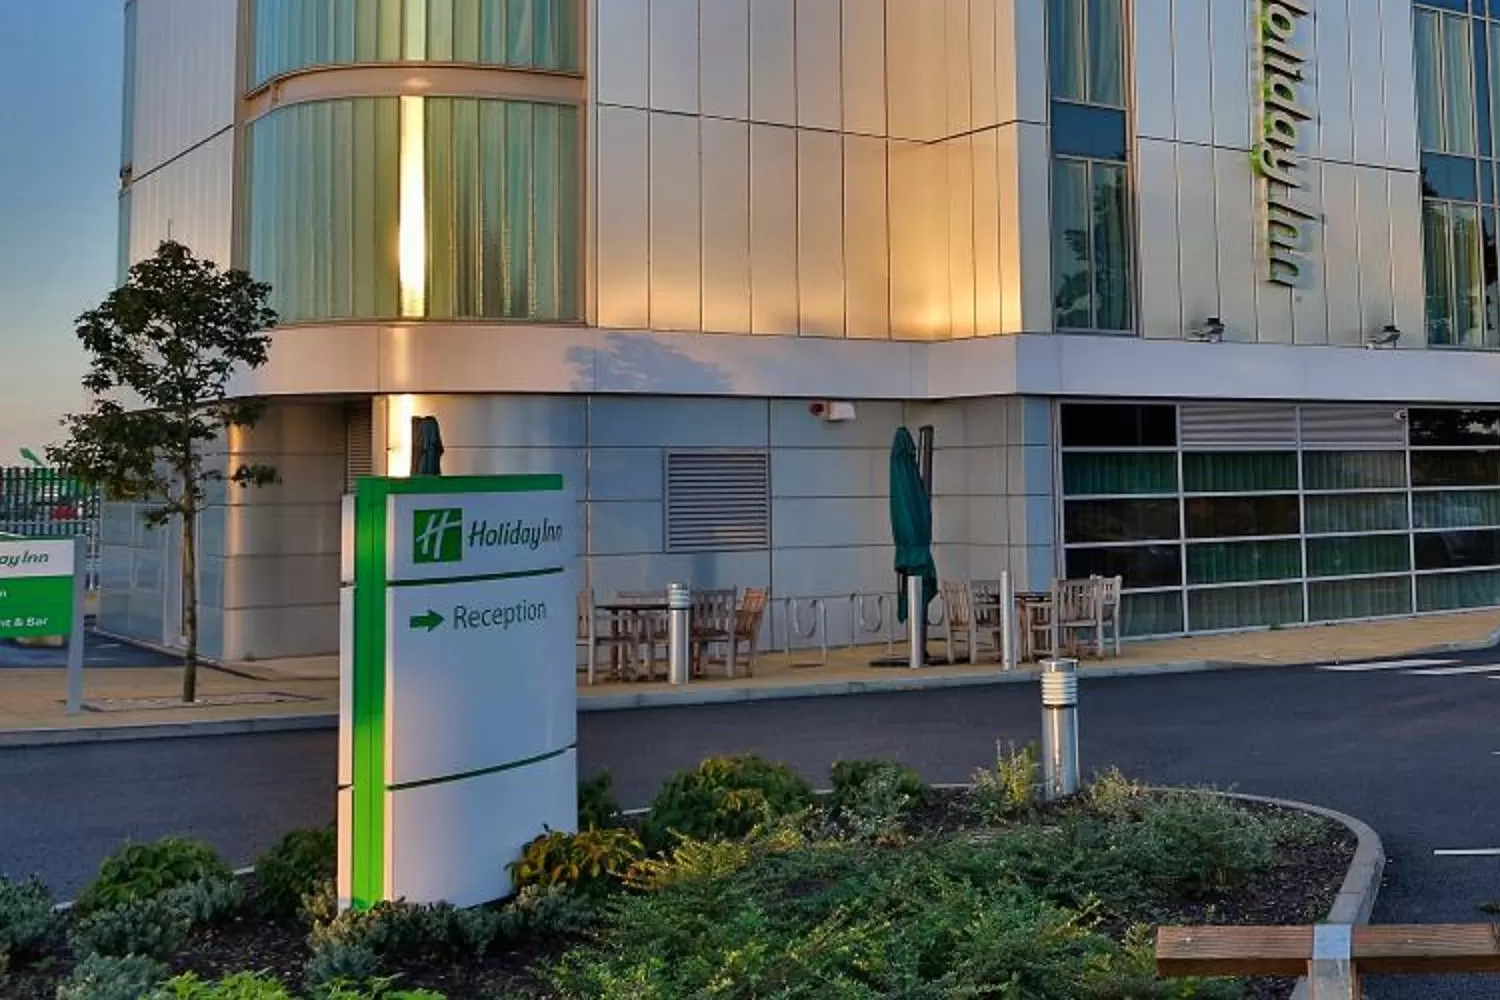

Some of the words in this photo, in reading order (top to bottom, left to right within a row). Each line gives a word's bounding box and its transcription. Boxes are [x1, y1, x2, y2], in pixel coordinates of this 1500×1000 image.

[1266, 200, 1318, 289] Inn
[468, 519, 541, 550] Holiday
[542, 517, 563, 541] Inn
[21, 550, 49, 563] Inn
[26, 617, 48, 627] Bar
[453, 600, 547, 630] Reception
